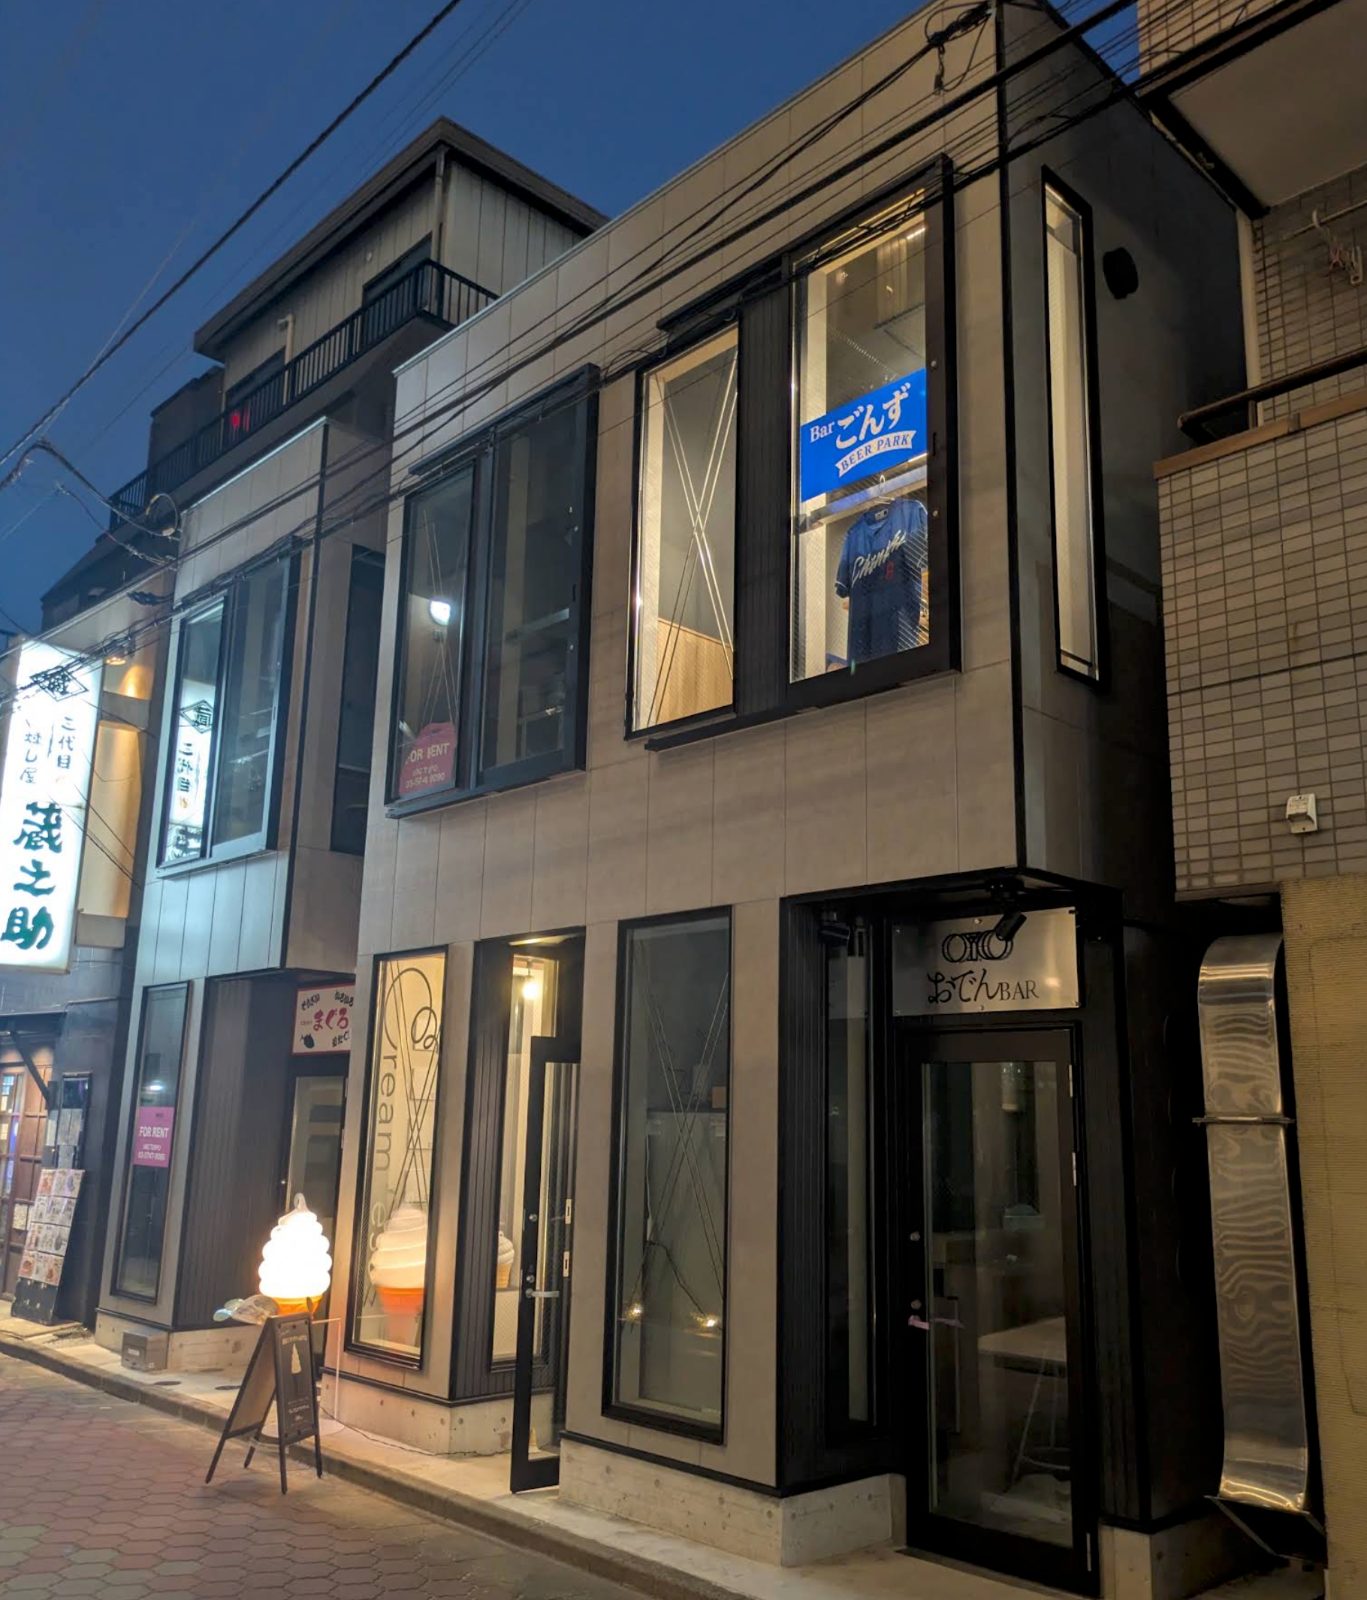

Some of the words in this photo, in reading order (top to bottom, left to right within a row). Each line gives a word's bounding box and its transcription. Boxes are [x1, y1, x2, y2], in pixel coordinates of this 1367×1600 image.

[810, 421, 835, 443] Bar
[836, 382, 912, 449] ごんず
[841, 447, 873, 472] BEER
[876, 433, 910, 451] PARK
[0, 801, 62, 950] 蔵之助
[313, 1007, 350, 1032] まぐろ
[139, 1126, 151, 1137] FOR
[151, 1126, 169, 1138] RENT
